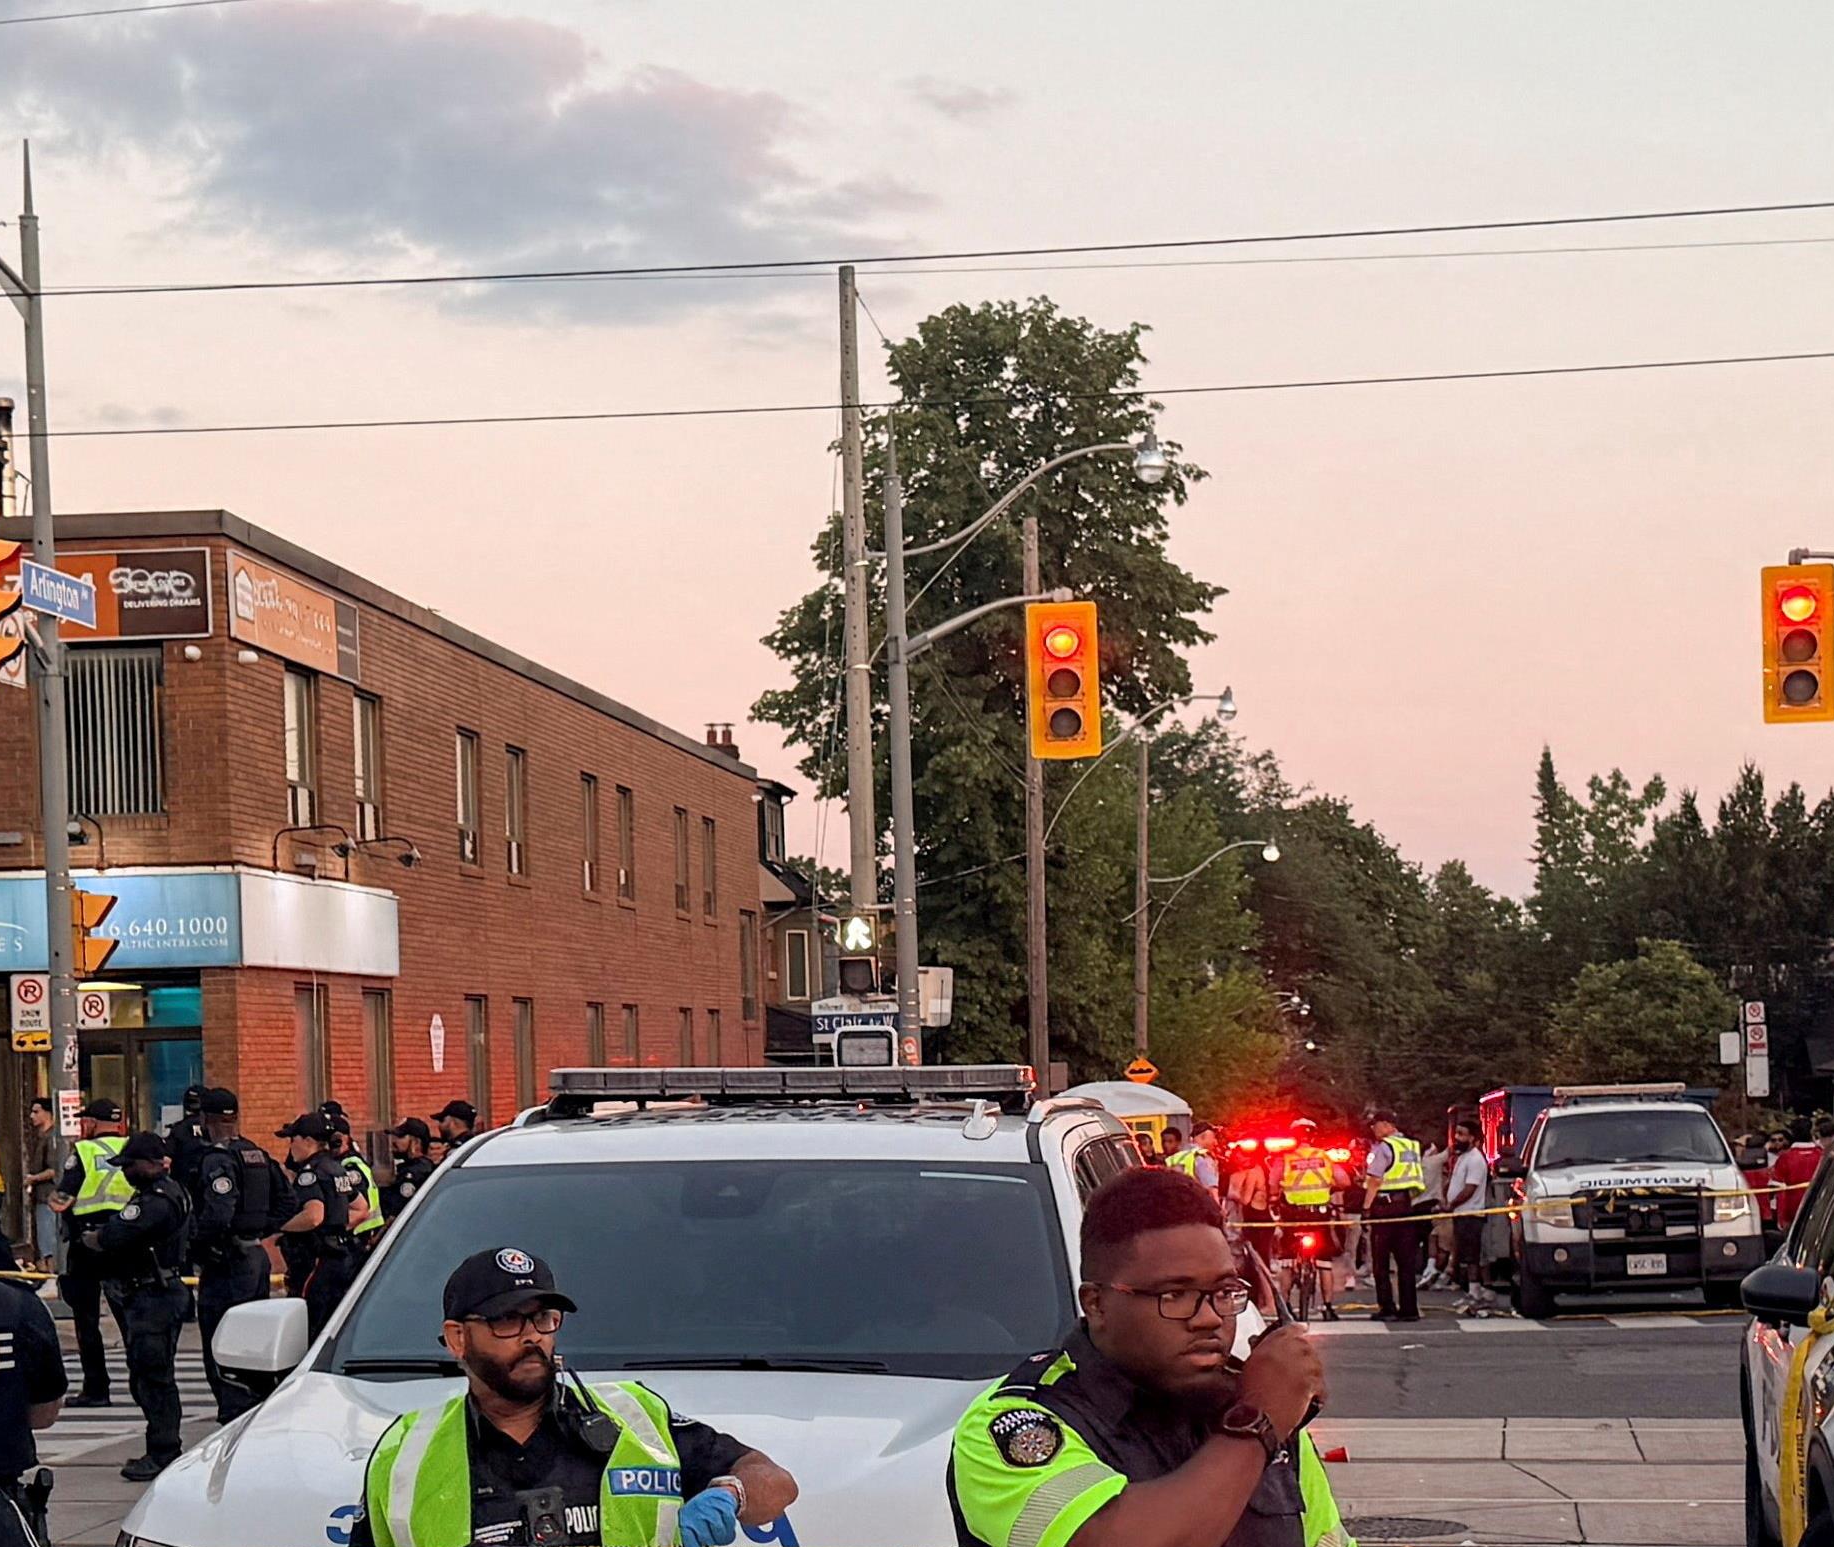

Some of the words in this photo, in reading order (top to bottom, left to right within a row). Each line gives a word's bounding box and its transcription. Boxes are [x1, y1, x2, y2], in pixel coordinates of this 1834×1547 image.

[30, 568, 80, 612] Arlington
[90, 916, 229, 936] 16.640.1000
[20, 1018, 42, 1028] ROUTE
[816, 1017, 829, 1031] St
[620, 1469, 682, 1491] POLIC
